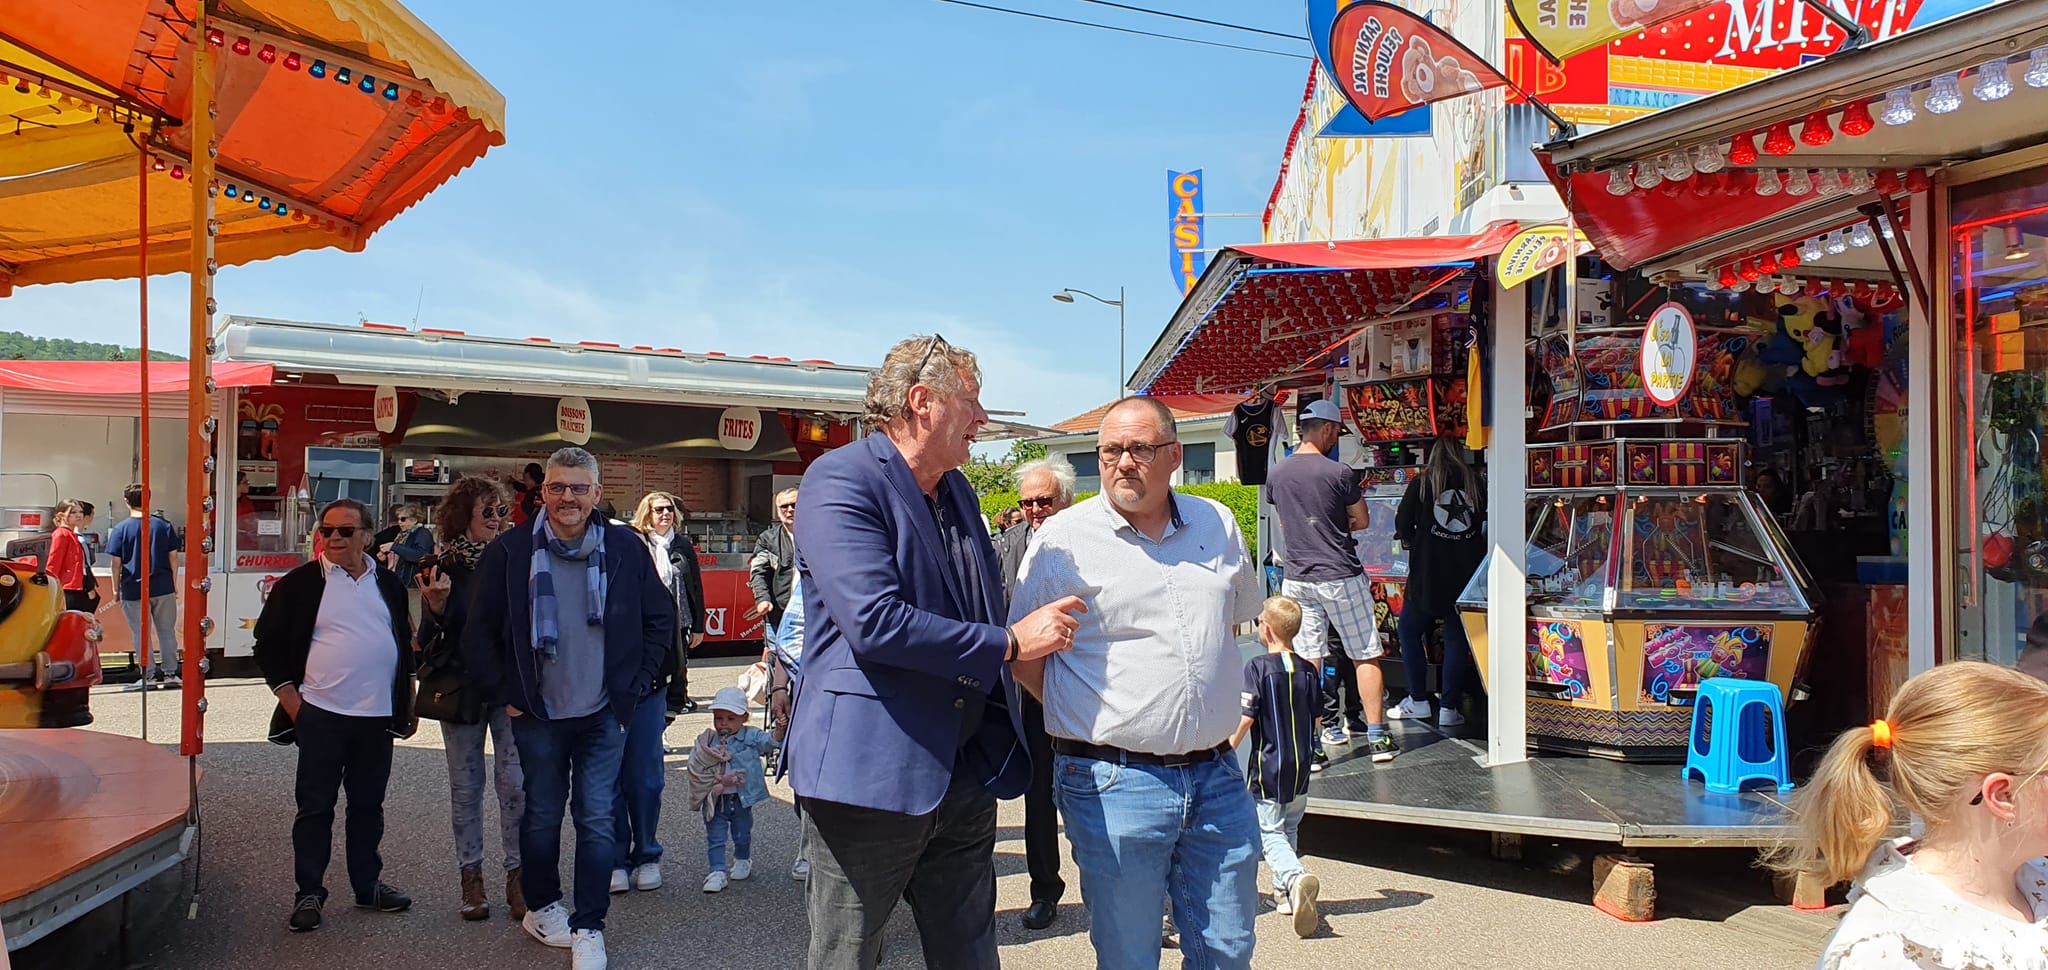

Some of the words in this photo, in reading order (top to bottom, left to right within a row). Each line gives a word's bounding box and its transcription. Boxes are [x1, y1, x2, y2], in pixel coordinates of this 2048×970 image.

[1651, 372, 1684, 389] PARTIE
[561, 406, 586, 420] BOISSONS
[723, 418, 754, 440] FRITES
